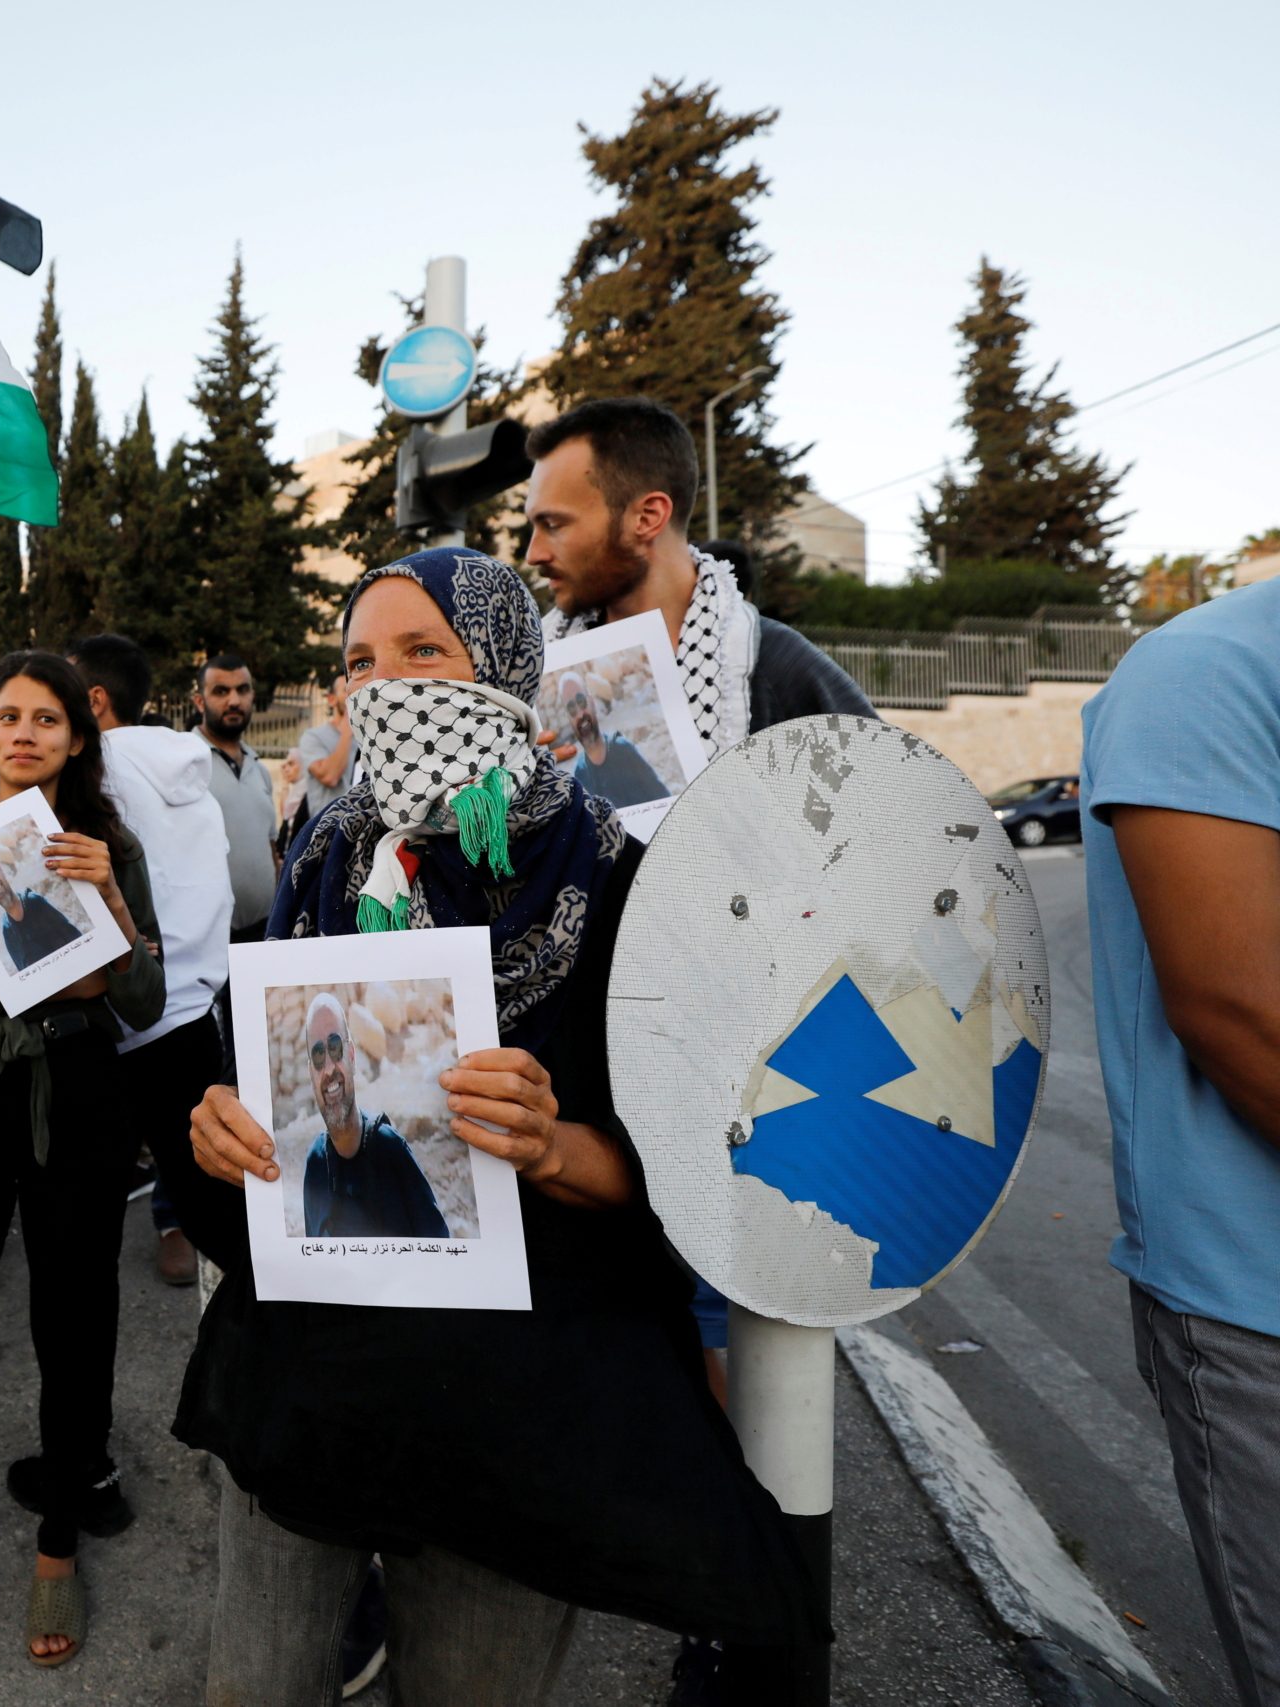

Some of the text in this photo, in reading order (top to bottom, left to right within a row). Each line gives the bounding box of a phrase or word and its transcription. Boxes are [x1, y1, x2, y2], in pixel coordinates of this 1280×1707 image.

[349, 1243, 369, 1255] بنات
[372, 1243, 389, 1256] نزار
[391, 1243, 414, 1256] الحرة
[416, 1242, 442, 1254] الكلمة
[446, 1244, 468, 1257] شهيد
